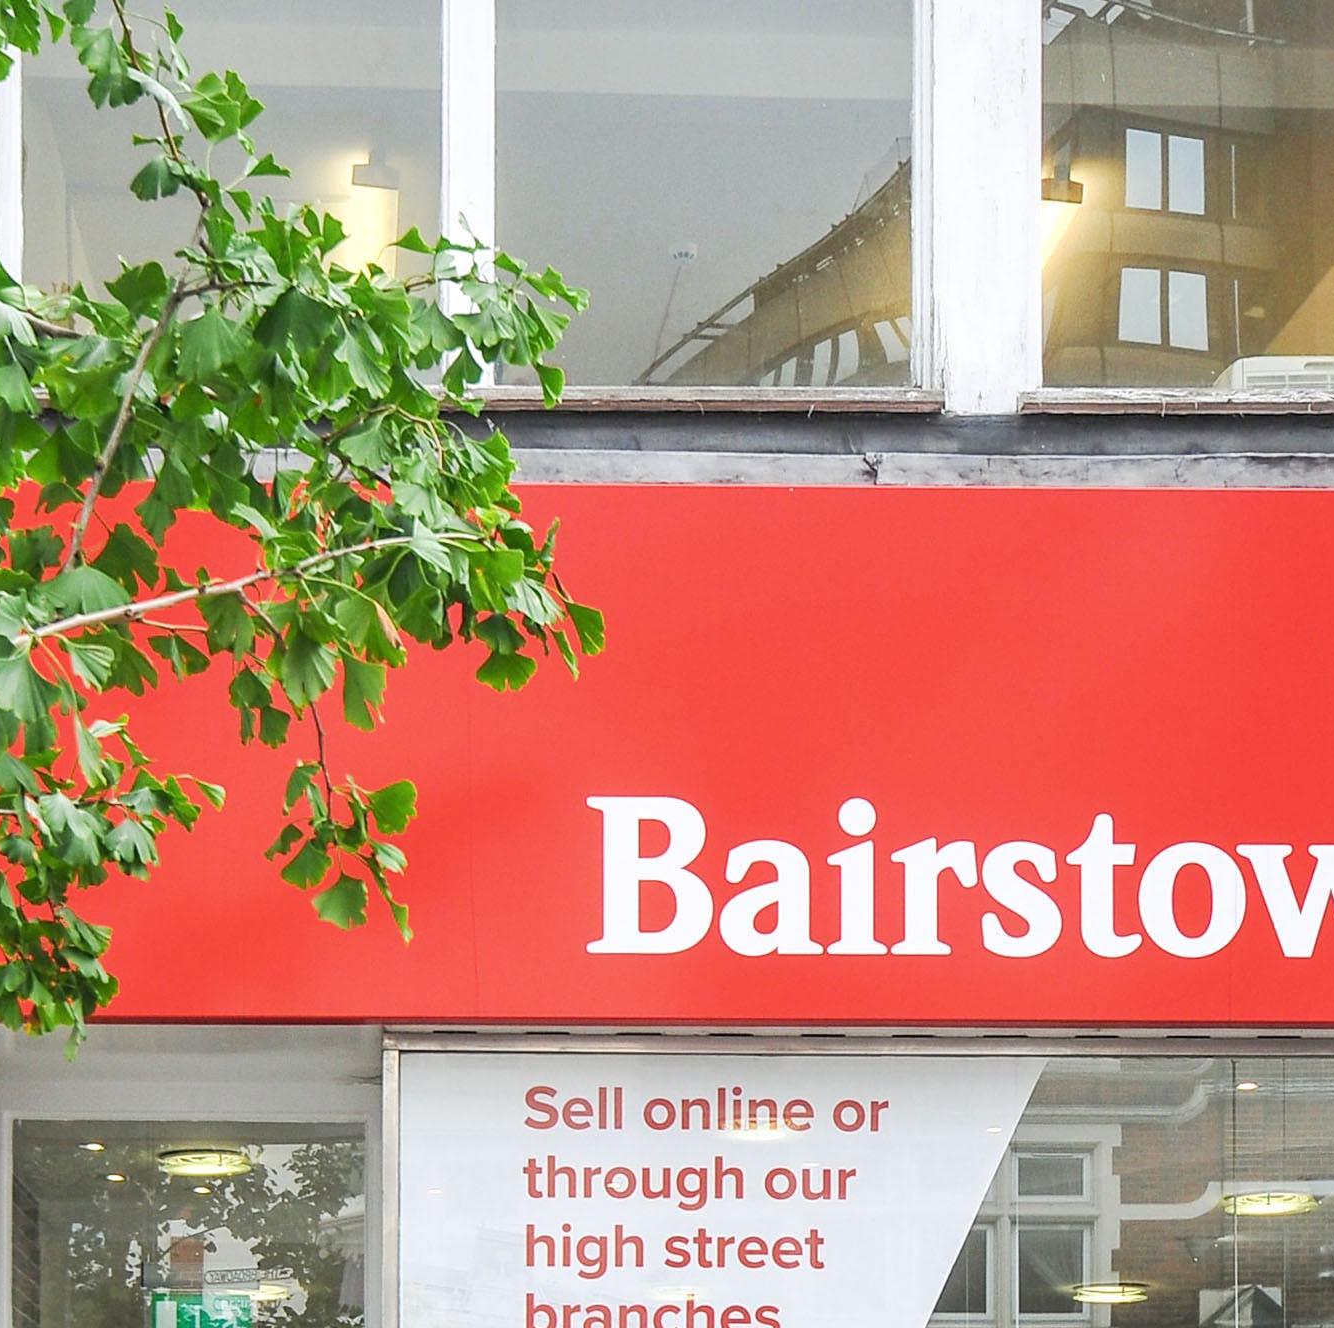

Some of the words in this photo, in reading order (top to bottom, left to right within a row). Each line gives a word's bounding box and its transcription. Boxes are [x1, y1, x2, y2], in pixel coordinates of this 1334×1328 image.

[524, 1086, 623, 1131] Sell
[643, 1087, 814, 1132] online
[832, 1096, 889, 1132] or
[523, 1156, 744, 1210] through
[764, 1166, 856, 1201] our
[525, 1224, 645, 1279] high
[664, 1228, 824, 1270] street
